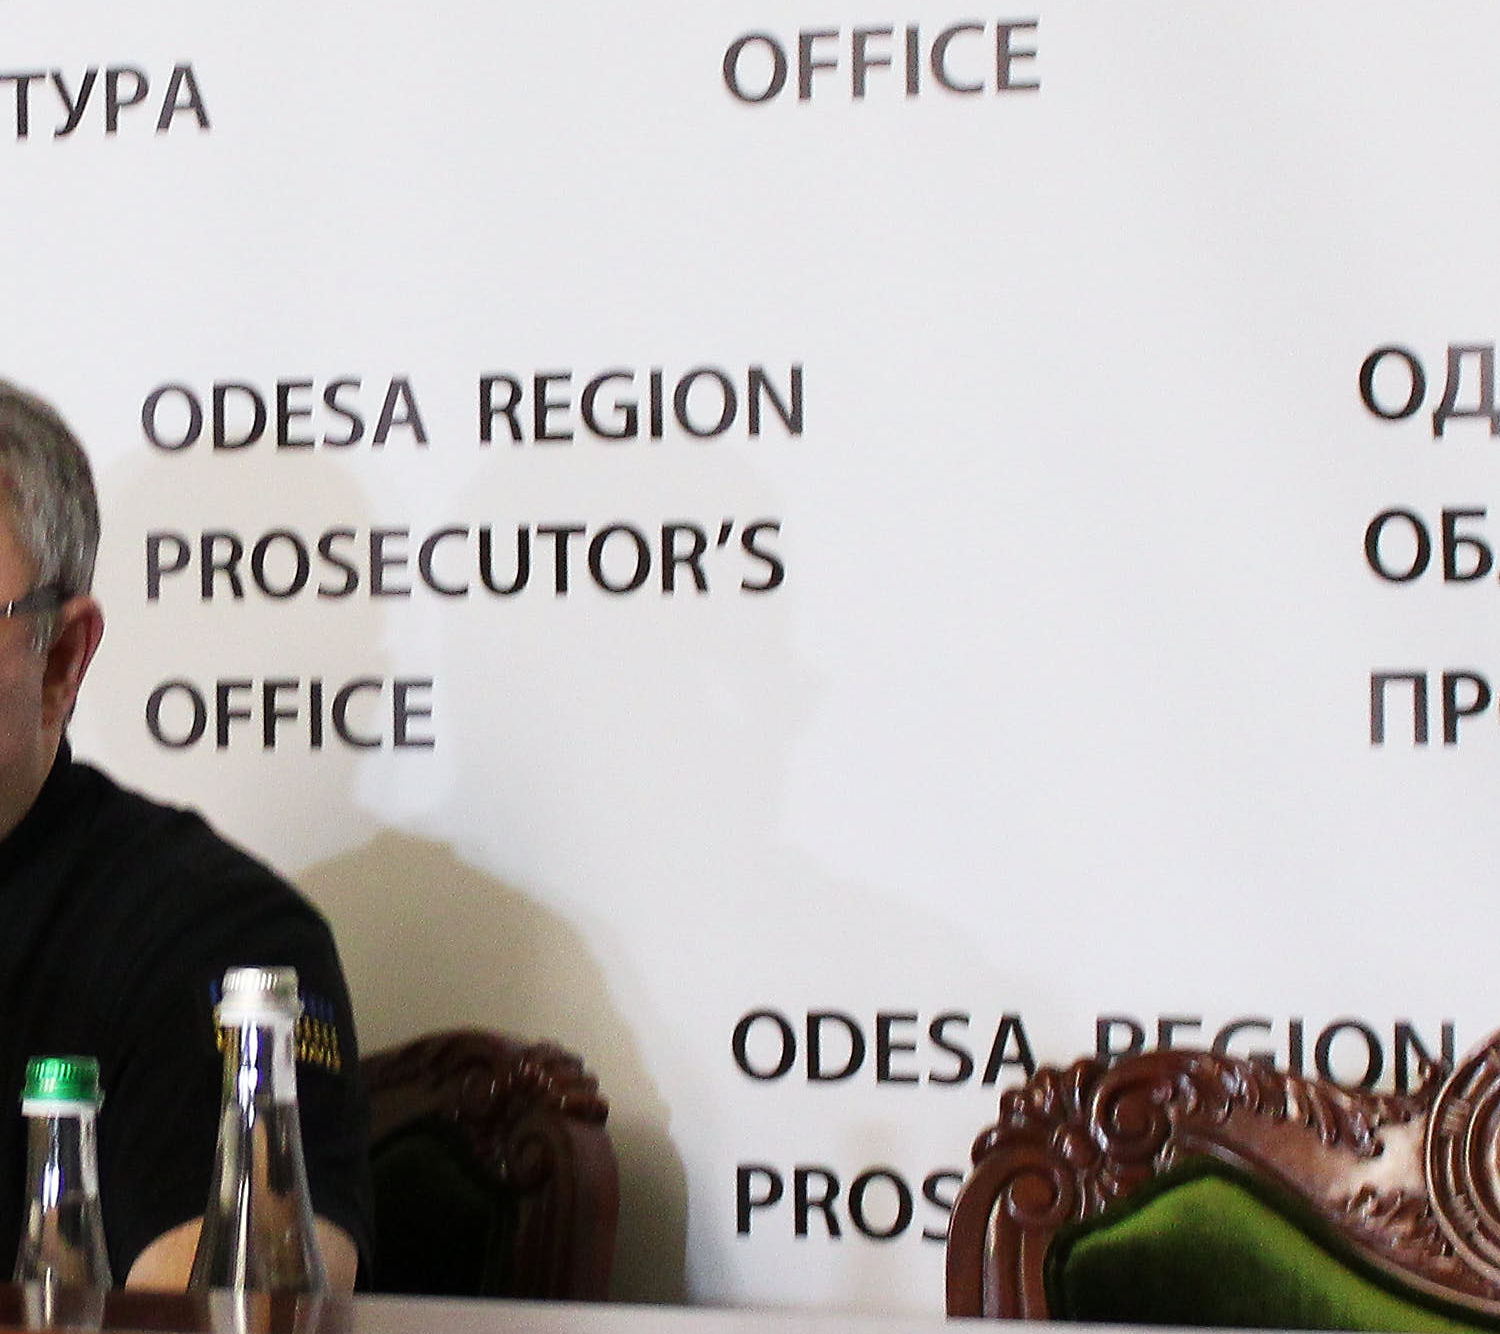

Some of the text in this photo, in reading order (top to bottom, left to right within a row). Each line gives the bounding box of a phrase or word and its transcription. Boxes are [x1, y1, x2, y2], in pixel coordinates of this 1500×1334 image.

[721, 18, 1042, 107] OFFICE
[140, 364, 805, 456] ODESA REGION
[145, 519, 786, 602] PROSECUTOR'S
[144, 677, 437, 752] OFFICE
[730, 1007, 1035, 1084] ODESA
